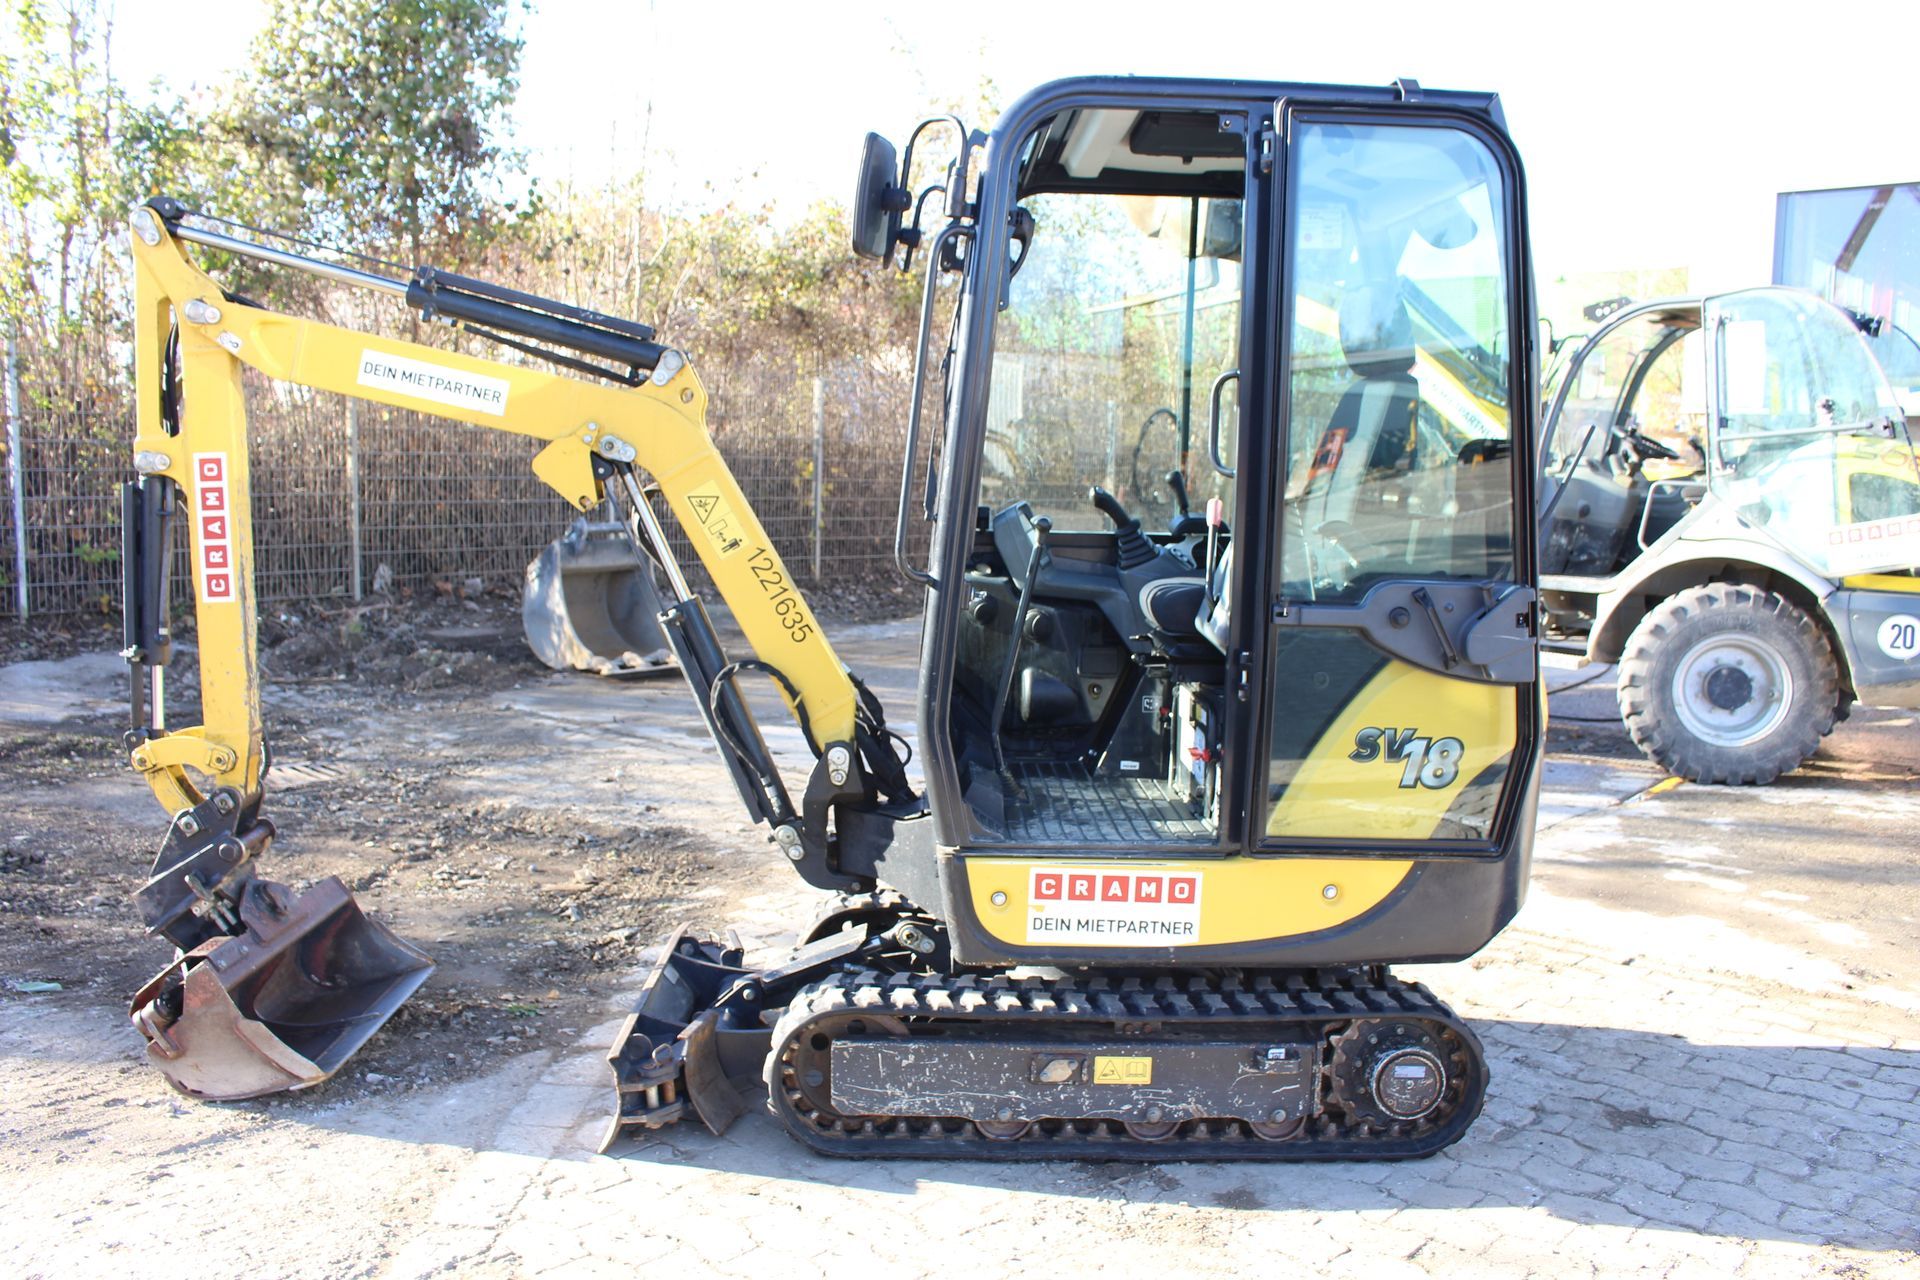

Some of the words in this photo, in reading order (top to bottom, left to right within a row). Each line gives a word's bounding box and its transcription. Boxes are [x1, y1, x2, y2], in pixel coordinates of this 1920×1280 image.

[363, 361, 397, 379] DEIN
[400, 369, 502, 404] MIETPARTNER
[202, 461, 228, 594] CRAMO
[1829, 519, 1920, 546] RAM
[747, 547, 814, 643] 1221635
[1889, 623, 1915, 650] 20
[1038, 876, 1193, 902] CRAMO
[1032, 917, 1071, 932] DEIN
[1077, 918, 1194, 935] MIETPARTNER
